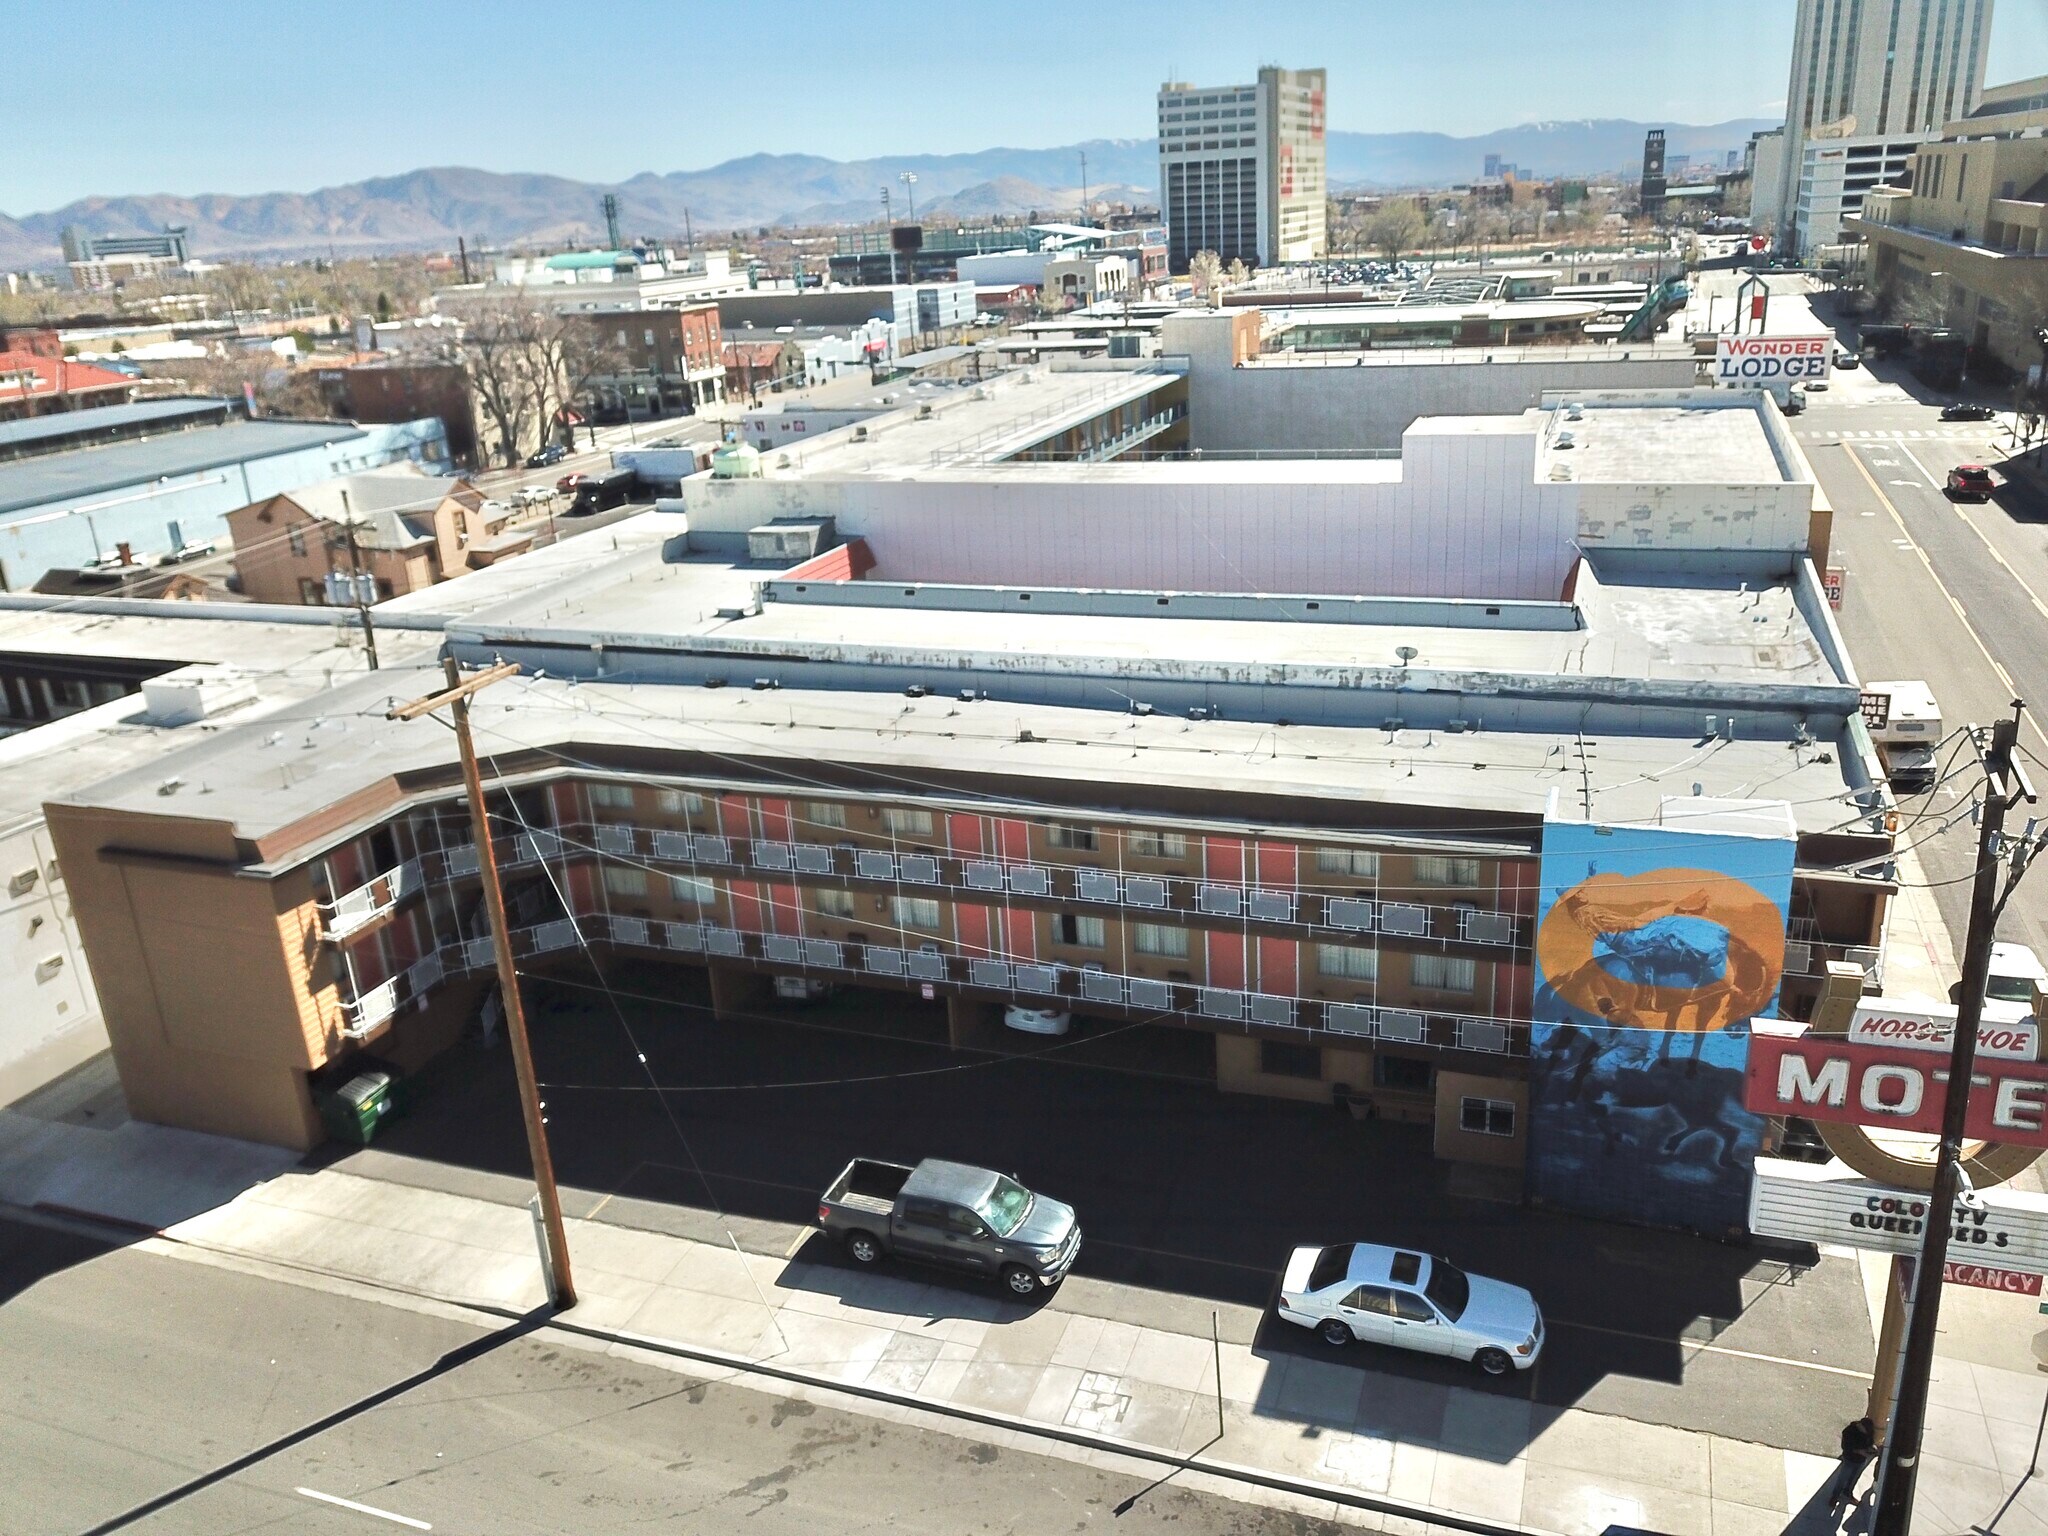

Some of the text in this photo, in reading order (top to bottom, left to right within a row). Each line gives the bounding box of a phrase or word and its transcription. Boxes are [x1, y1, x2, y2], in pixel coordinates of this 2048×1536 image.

[1720, 338, 1829, 355] WONDER
[1720, 357, 1826, 377] LODGE
[1860, 696, 1887, 706] ME
[1867, 1196, 1988, 1226] COLO TV
[1943, 1263, 2038, 1292] ACANCY
